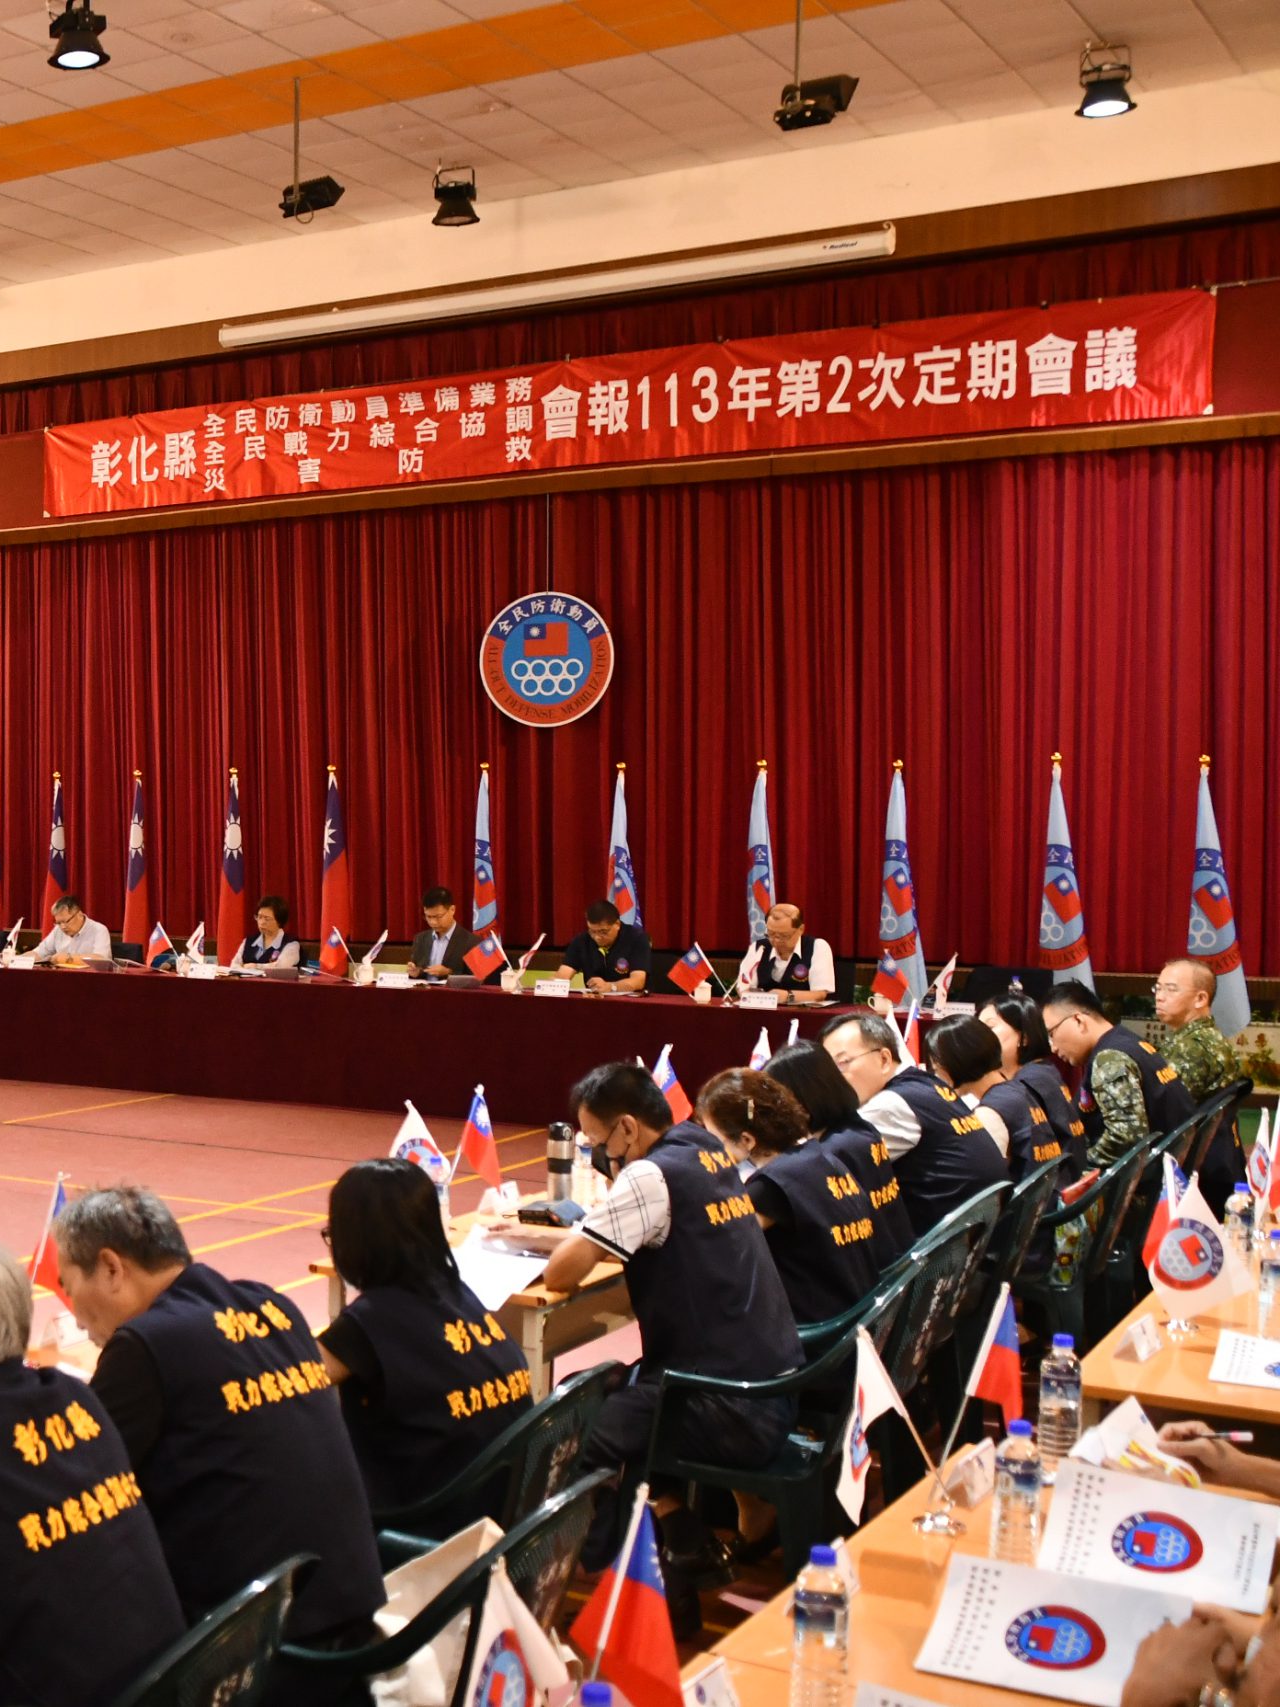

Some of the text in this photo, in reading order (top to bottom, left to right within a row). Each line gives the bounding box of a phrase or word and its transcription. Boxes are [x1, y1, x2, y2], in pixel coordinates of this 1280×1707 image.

[204, 377, 532, 439] 全民防衛動員準備業務
[541, 327, 1136, 440] 會報113年第2次定期會議
[91, 431, 197, 489] 彰化縣
[204, 407, 532, 466] 全民戰力綜合協調
[498, 598, 599, 635] 全民防衛動員
[13, 1400, 102, 1467] 彰化縣
